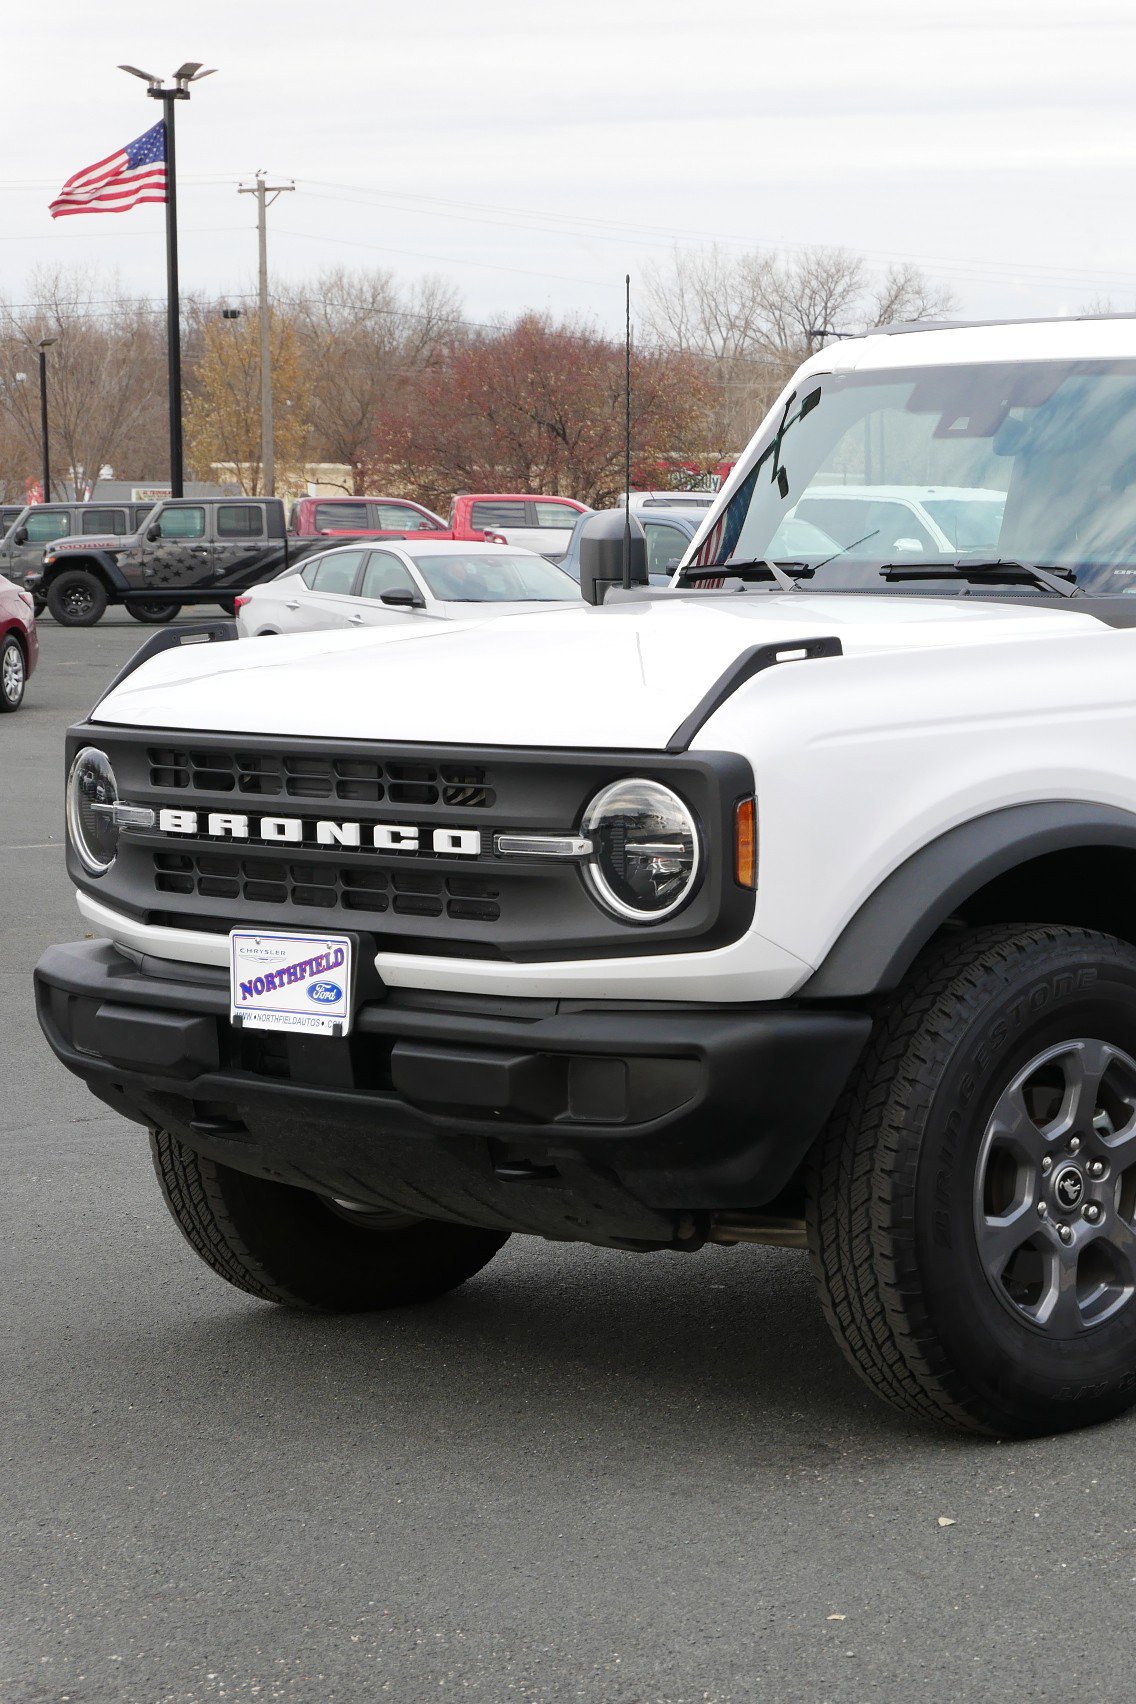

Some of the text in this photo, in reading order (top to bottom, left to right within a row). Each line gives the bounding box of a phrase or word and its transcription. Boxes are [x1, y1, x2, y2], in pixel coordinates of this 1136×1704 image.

[159, 808, 482, 855] BRONCO
[239, 947, 287, 956] CHRYSLER
[239, 947, 345, 1001] NORTHFIELD
[312, 983, 337, 1001] Ford
[932, 967, 1097, 1250] BRIDGESTONE
